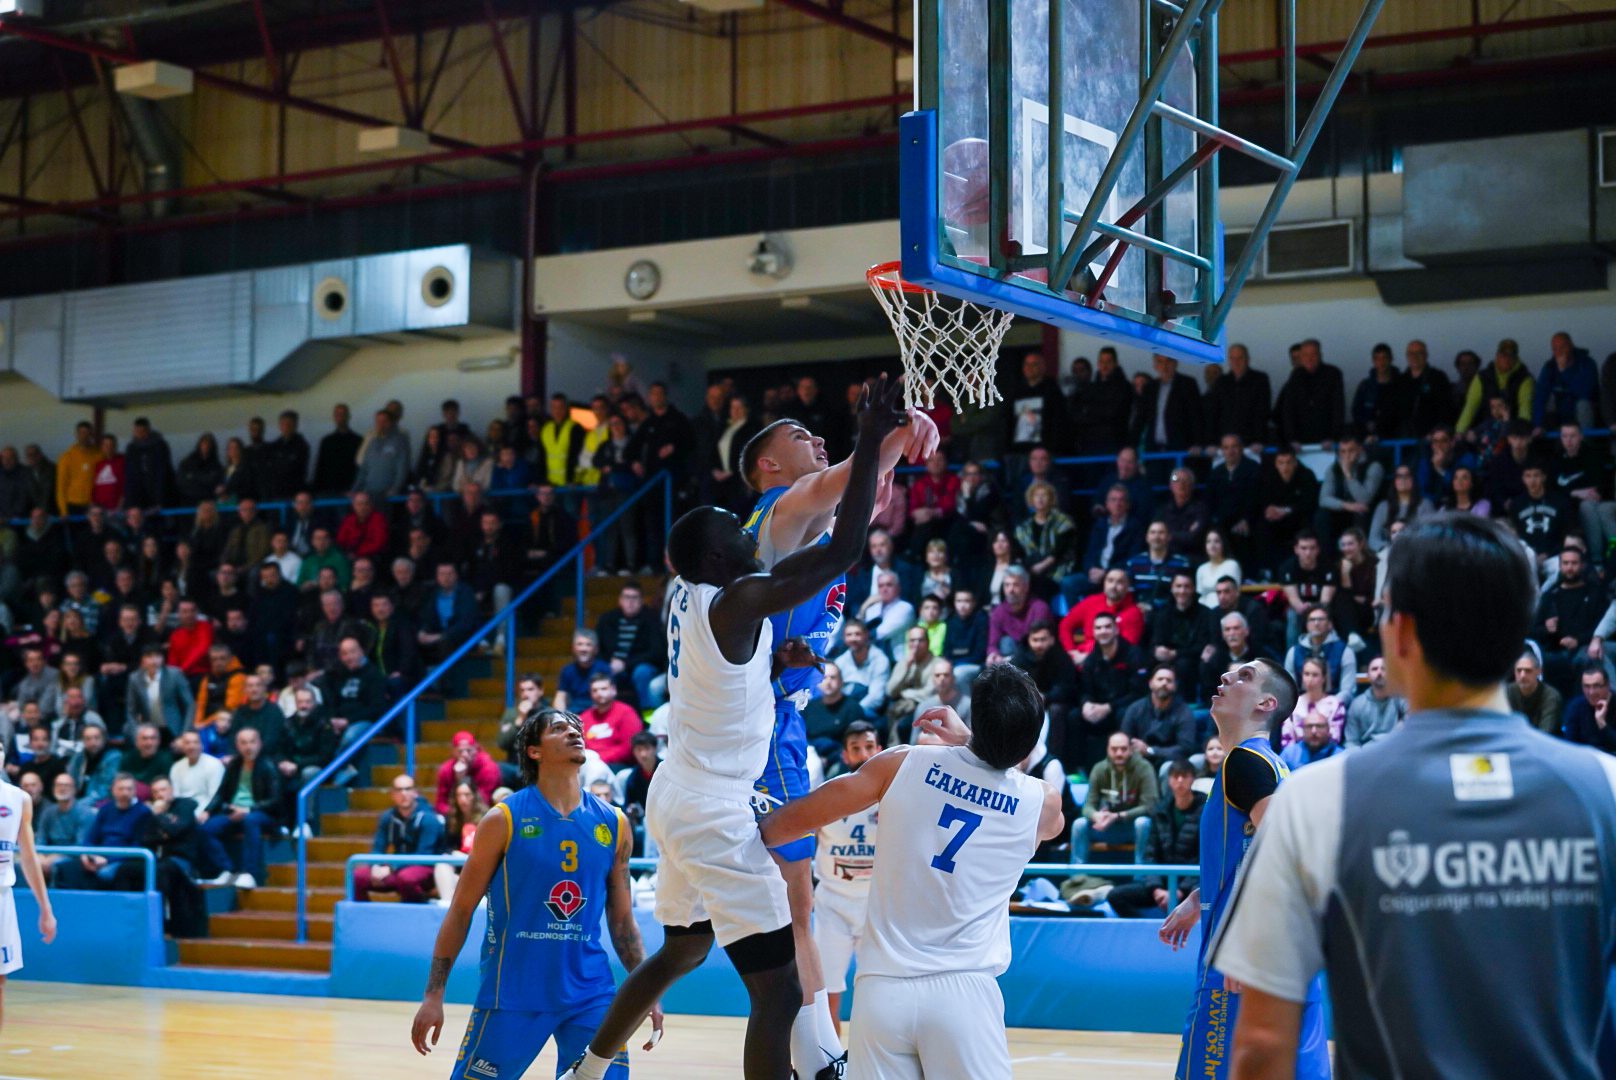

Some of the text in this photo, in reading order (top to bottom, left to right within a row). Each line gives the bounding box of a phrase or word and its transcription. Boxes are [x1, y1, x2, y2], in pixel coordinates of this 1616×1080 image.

[924, 762, 1020, 816] ČAKARUN
[560, 840, 579, 873] 3
[850, 824, 866, 843] 4
[930, 802, 984, 874] 7
[1433, 838, 1599, 889] GRAWE
